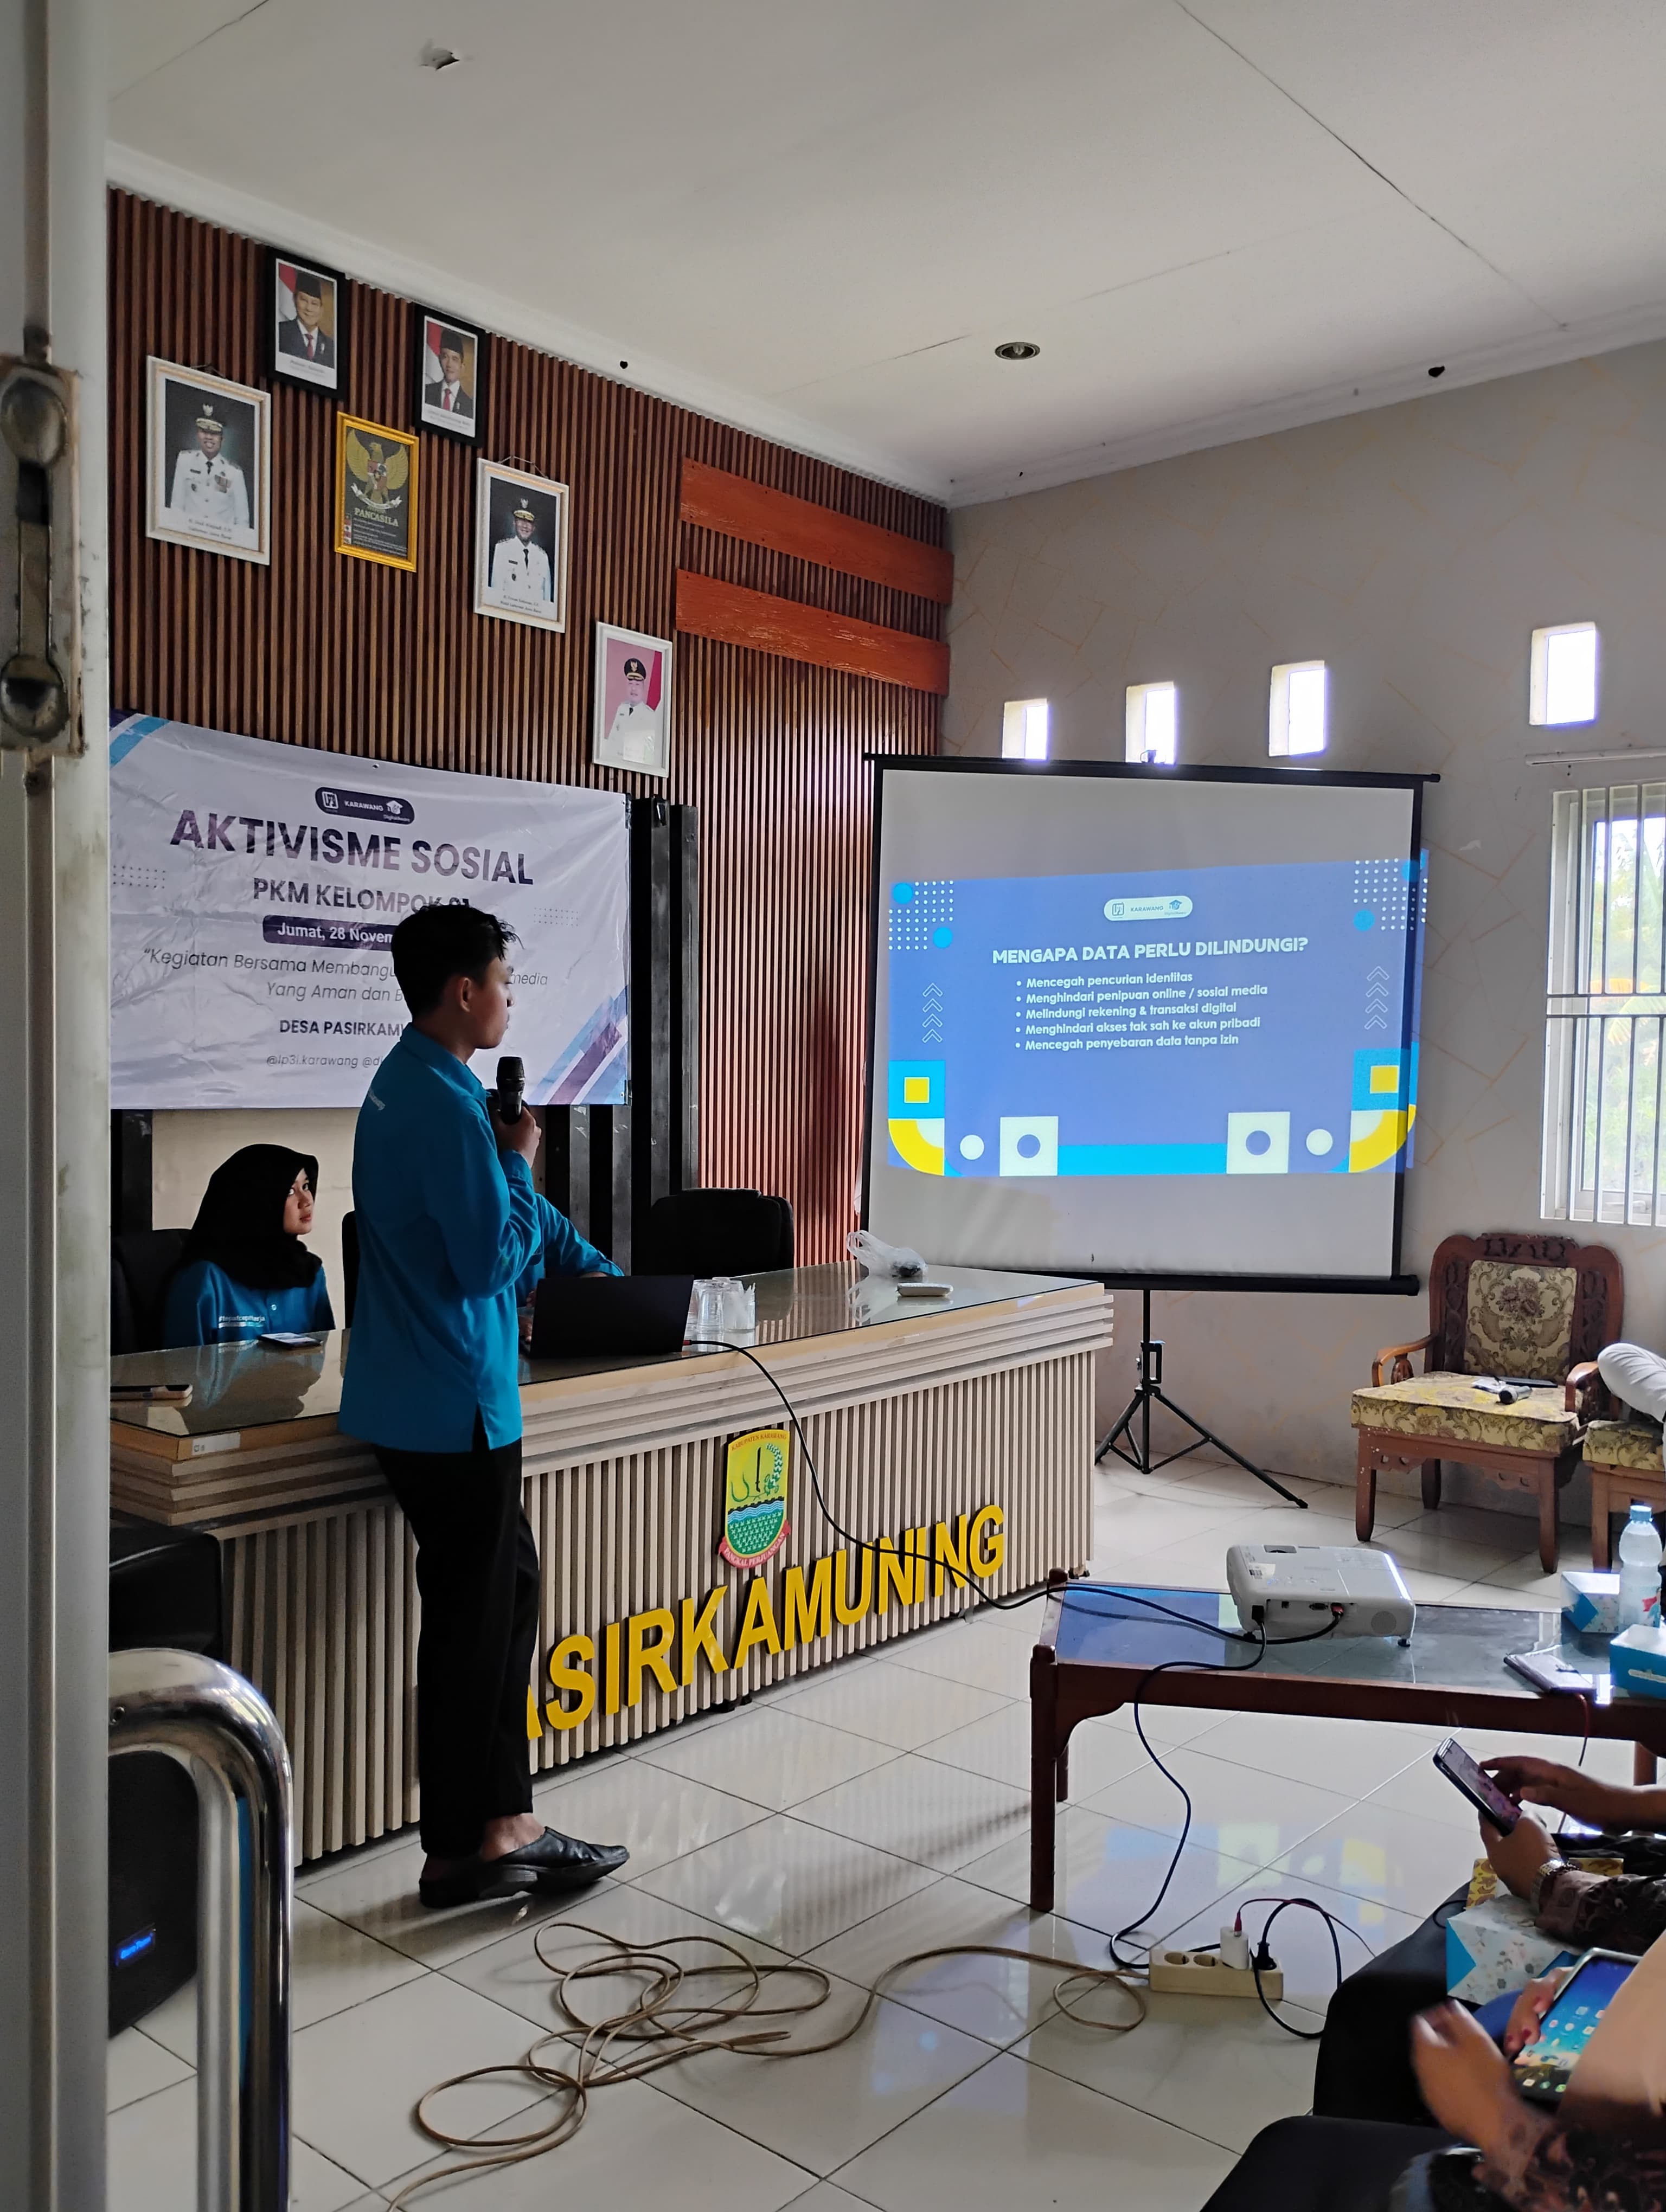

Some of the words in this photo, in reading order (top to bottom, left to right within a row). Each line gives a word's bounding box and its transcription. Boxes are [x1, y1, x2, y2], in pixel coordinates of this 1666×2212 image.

[354, 507, 399, 527] PANCASILA
[344, 800, 383, 812] KARAWANG
[170, 810, 401, 870] AKTIVISME
[411, 840, 533, 885] SOSIAL
[254, 878, 309, 904] PKM
[278, 923, 325, 941] Jumat,
[330, 927, 345, 940] 28
[993, 948, 1078, 963] MENGAPA
[1082, 945, 1130, 960] DATA
[1135, 942, 1191, 959] PERLU
[1195, 937, 1308, 956] DILINDUNGI?
[234, 955, 306, 972] Bersama
[1027, 976, 1085, 988] Mencegah
[1087, 974, 1143, 987] pencurian
[1146, 972, 1193, 983] identitas
[267, 982, 306, 1001] Yang
[311, 985, 356, 1000] Aman
[362, 987, 390, 1001] dan
[1026, 991, 1094, 1005] Menghindari
[1097, 990, 1149, 1002] penipuan
[1152, 988, 1186, 999] online
[1188, 988, 1195, 999] /
[1197, 986, 1228, 998] sosial
[1231, 985, 1267, 996] media
[1026, 1007, 1086, 1019] Melindungi
[1088, 1006, 1136, 1018] rekening
[1139, 1006, 1147, 1015] &
[1150, 1004, 1199, 1015] transaksi
[1201, 1002, 1236, 1015] digital
[280, 1020, 319, 1034] DESA
[1026, 1023, 1094, 1036] Menghindari
[1096, 1022, 1127, 1032] akses
[1130, 1021, 1147, 1031] tak
[1150, 1020, 1169, 1031] sah
[1172, 1020, 1186, 1030] ke
[1189, 1019, 1217, 1030] akun
[1220, 1017, 1260, 1031] pribadi
[1025, 1039, 1083, 1051] Mencegah
[1086, 1038, 1153, 1051] penyebaran
[1156, 1036, 1181, 1046] data
[1184, 1035, 1218, 1047] tanpa
[1220, 1034, 1239, 1045] izin
[266, 1054, 358, 1068] @lp3i.karawang
[731, 1435, 760, 1451] KABUPATEN
[724, 1547, 748, 1567] PANGKAL
[749, 1532, 785, 1566] PERJUANGAN
